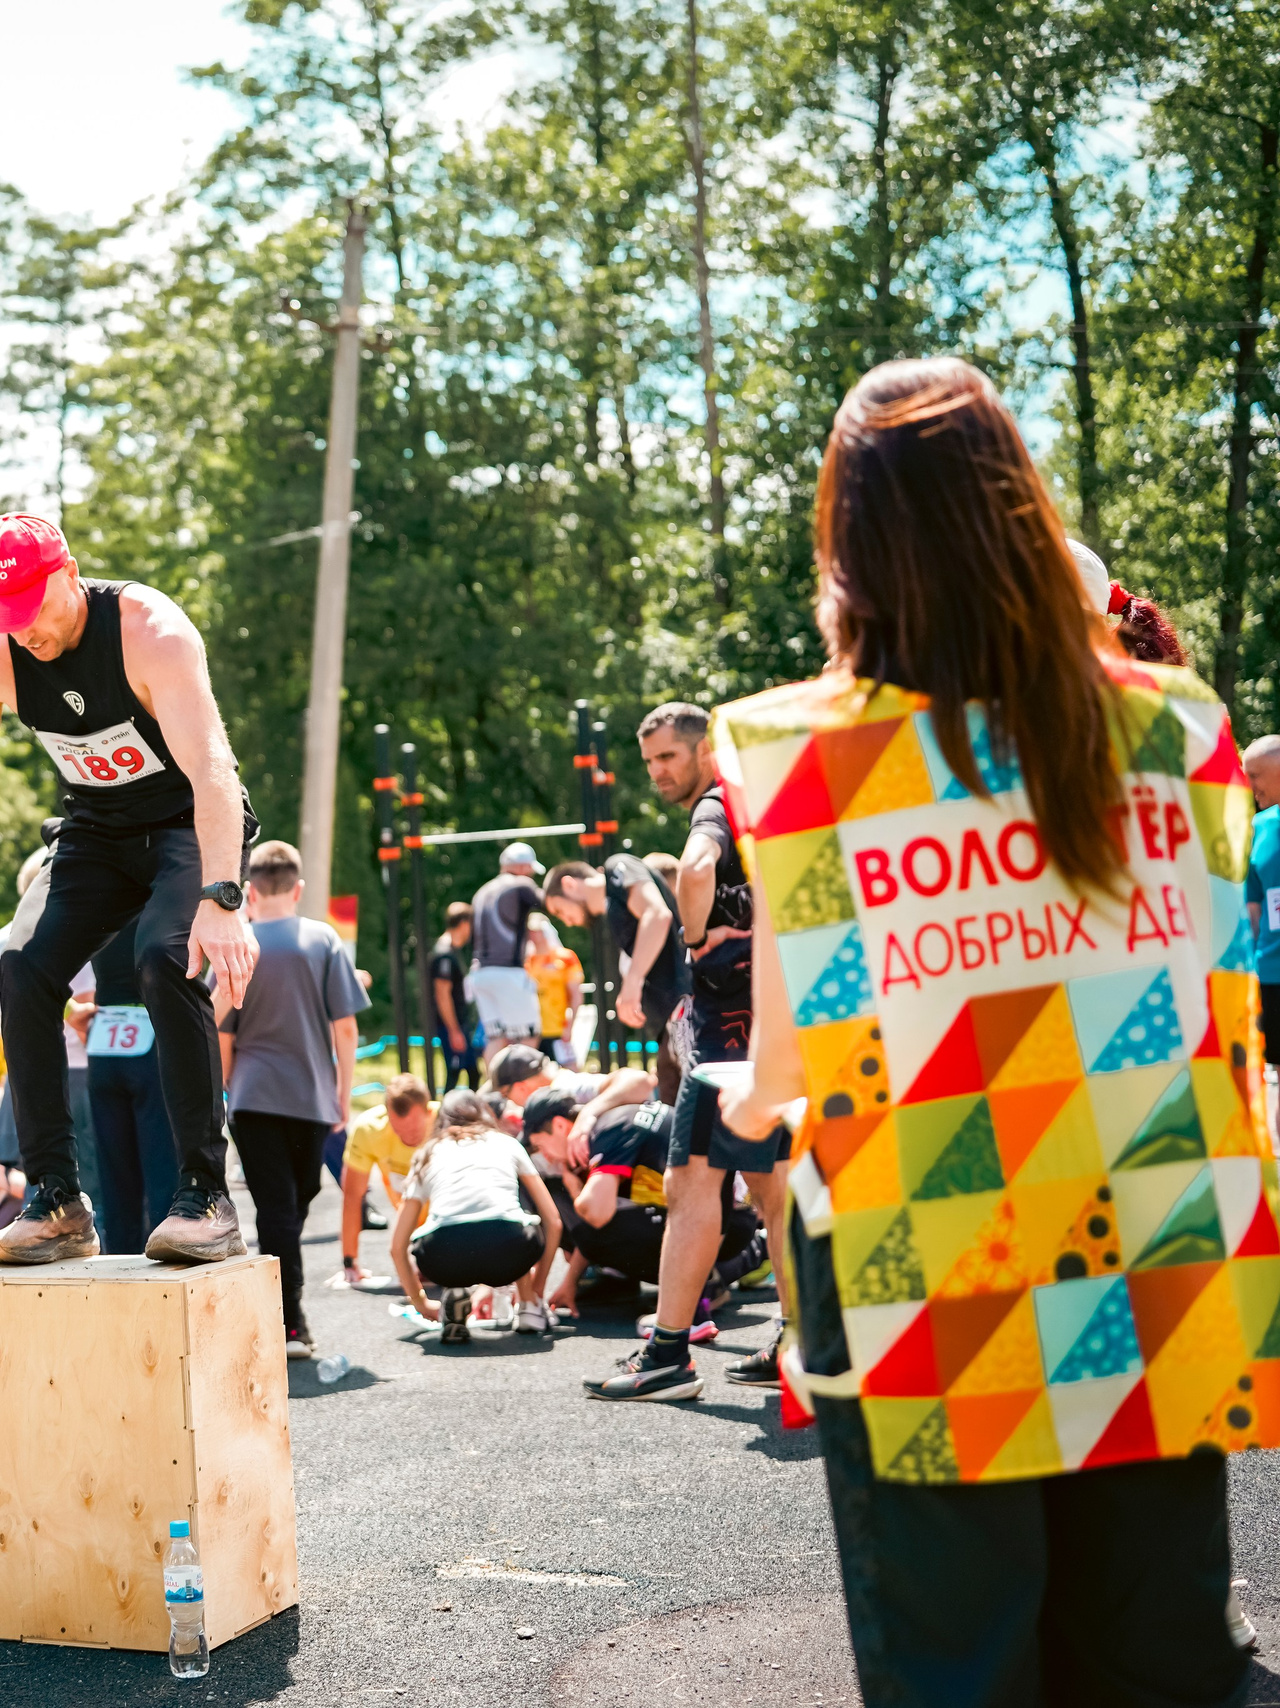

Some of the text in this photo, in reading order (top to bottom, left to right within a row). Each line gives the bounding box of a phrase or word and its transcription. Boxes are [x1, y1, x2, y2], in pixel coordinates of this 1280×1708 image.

[57, 744, 99, 756] BOGAL
[61, 746, 145, 781] 189
[854, 785, 1191, 908] ВОЛОТЁР
[882, 896, 1099, 996] ДОБРЫХ
[108, 1023, 140, 1049] 13
